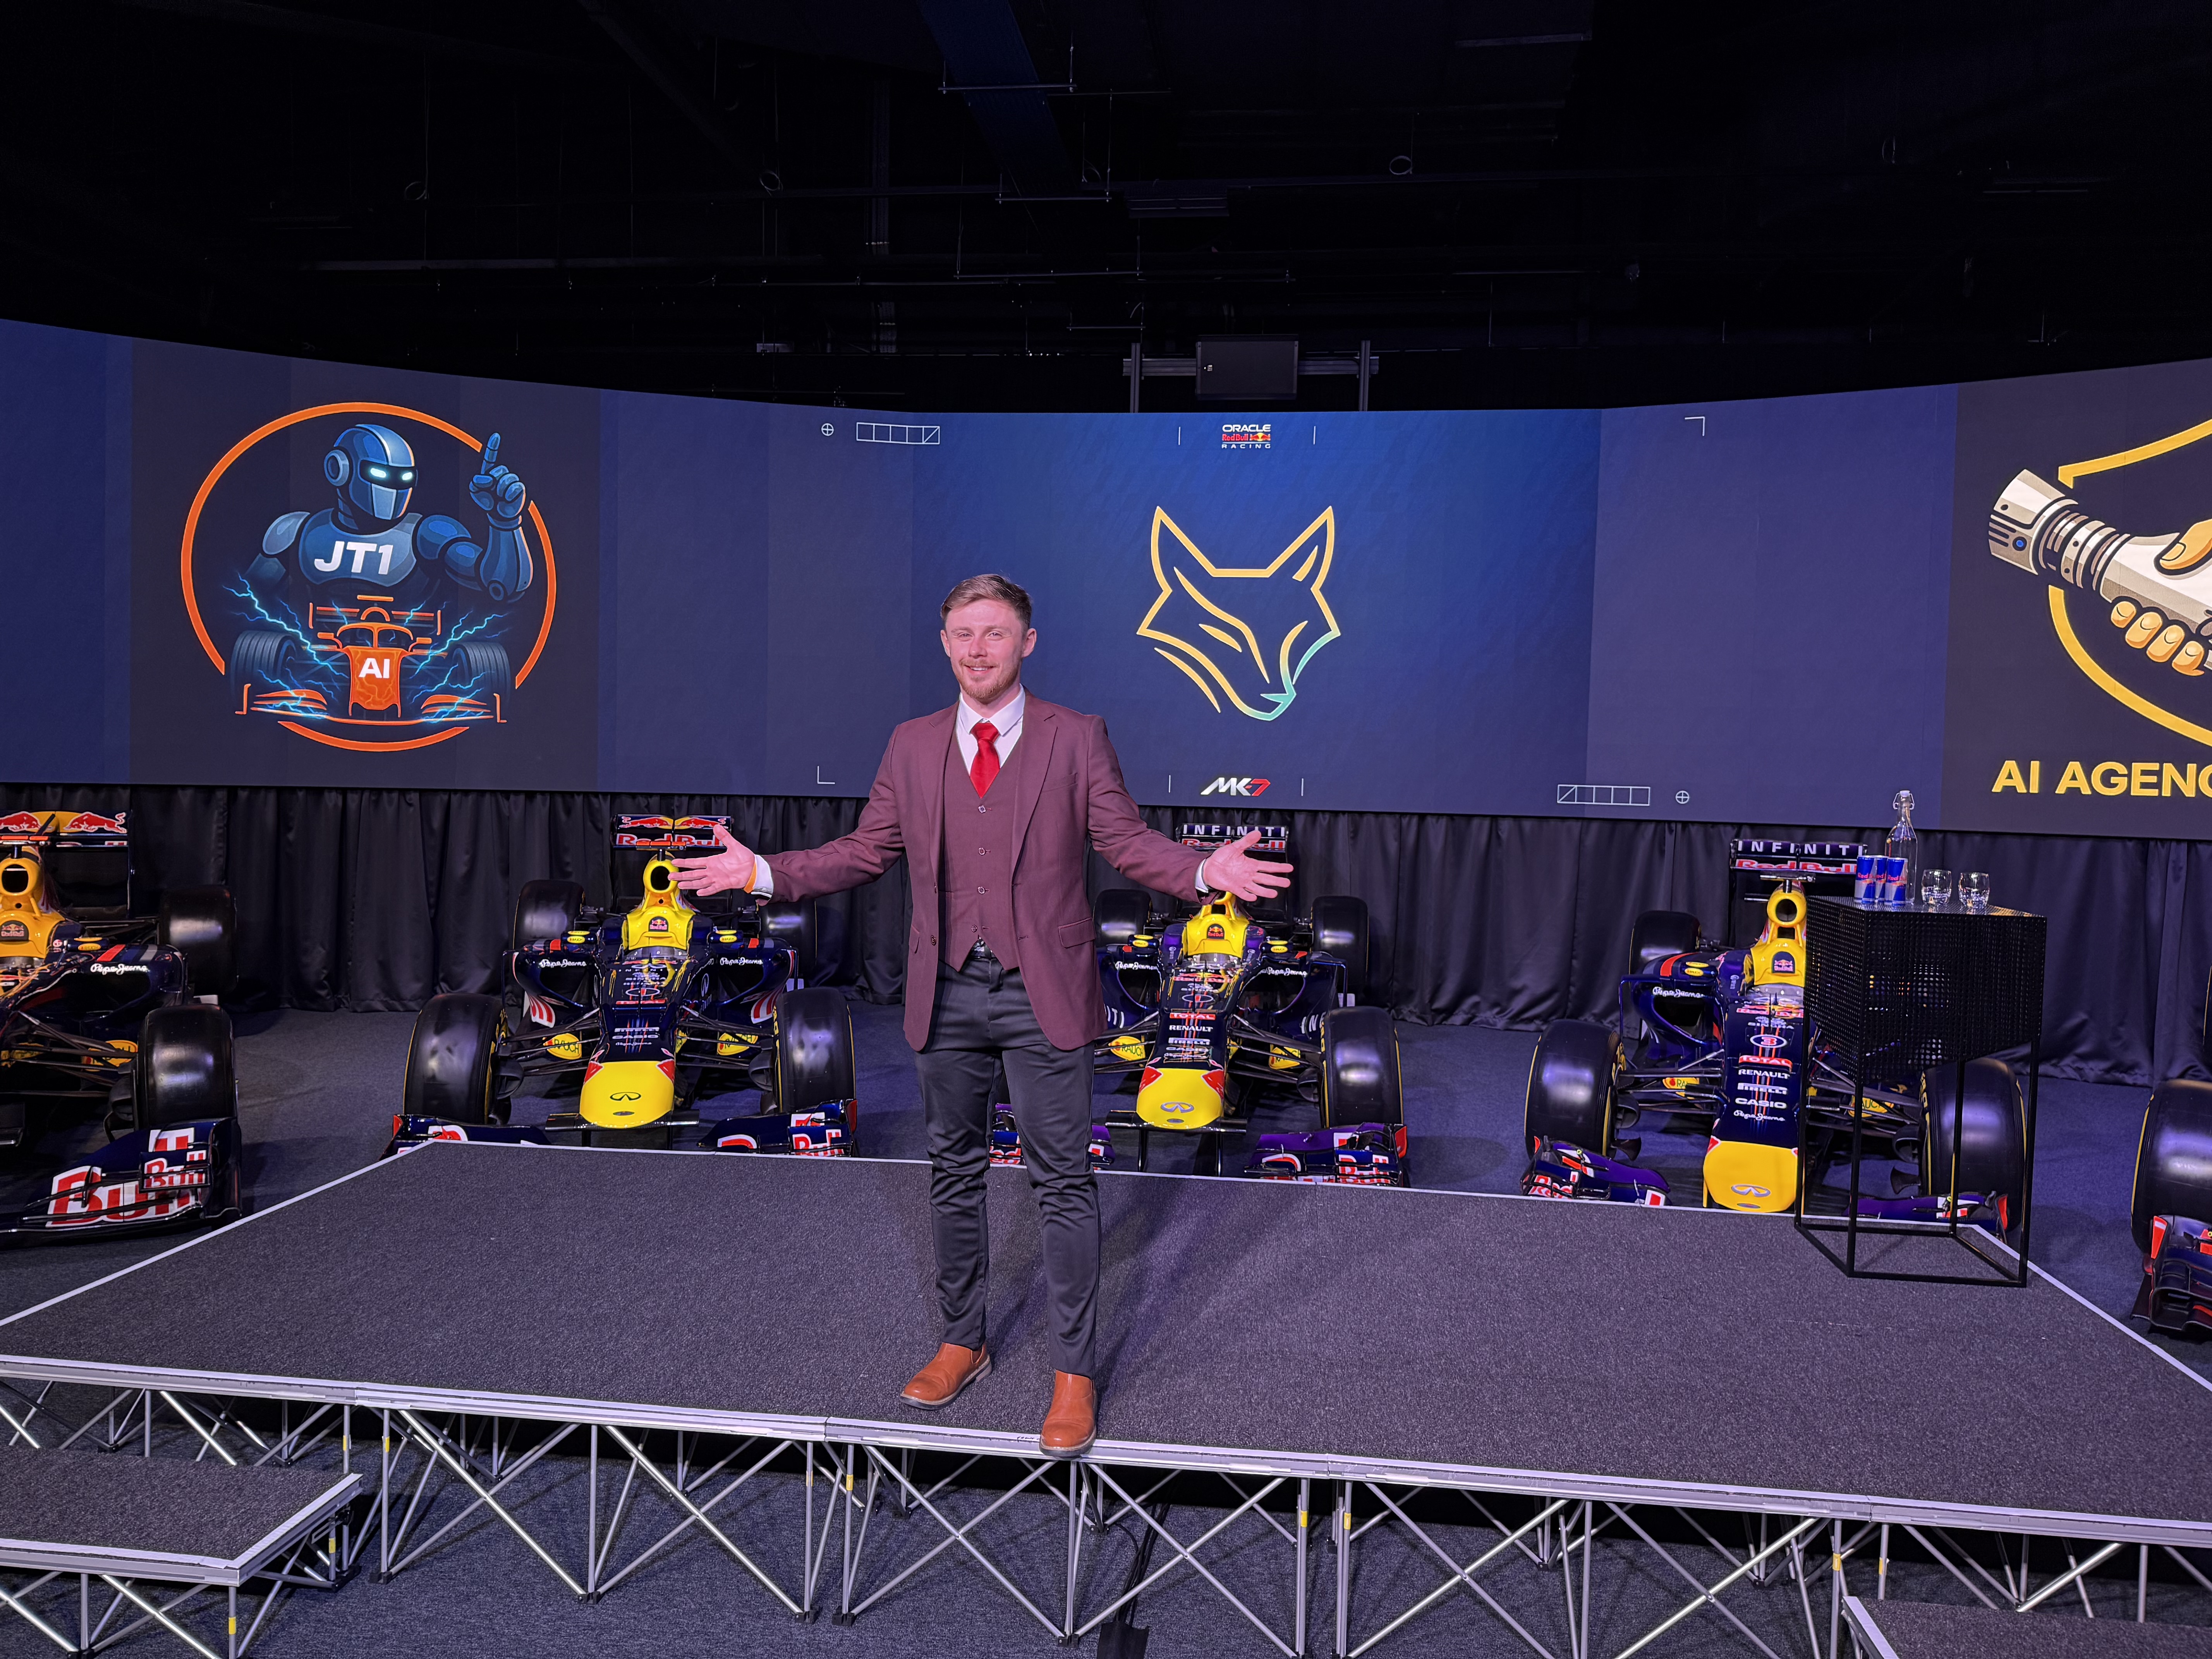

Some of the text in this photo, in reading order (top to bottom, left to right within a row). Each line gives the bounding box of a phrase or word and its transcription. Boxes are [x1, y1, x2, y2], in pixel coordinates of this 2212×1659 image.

[1222, 424, 1271, 432] ORACLE
[314, 541, 393, 575] JT1
[358, 658, 390, 678] AI
[1992, 760, 2040, 793] AI
[675, 834, 725, 847] Bul
[1738, 840, 1863, 856] INFINITI
[1743, 1055, 1788, 1066] TOTAL
[1738, 1069, 1790, 1079] RENAULT
[1735, 1097, 1787, 1109] CASIO
